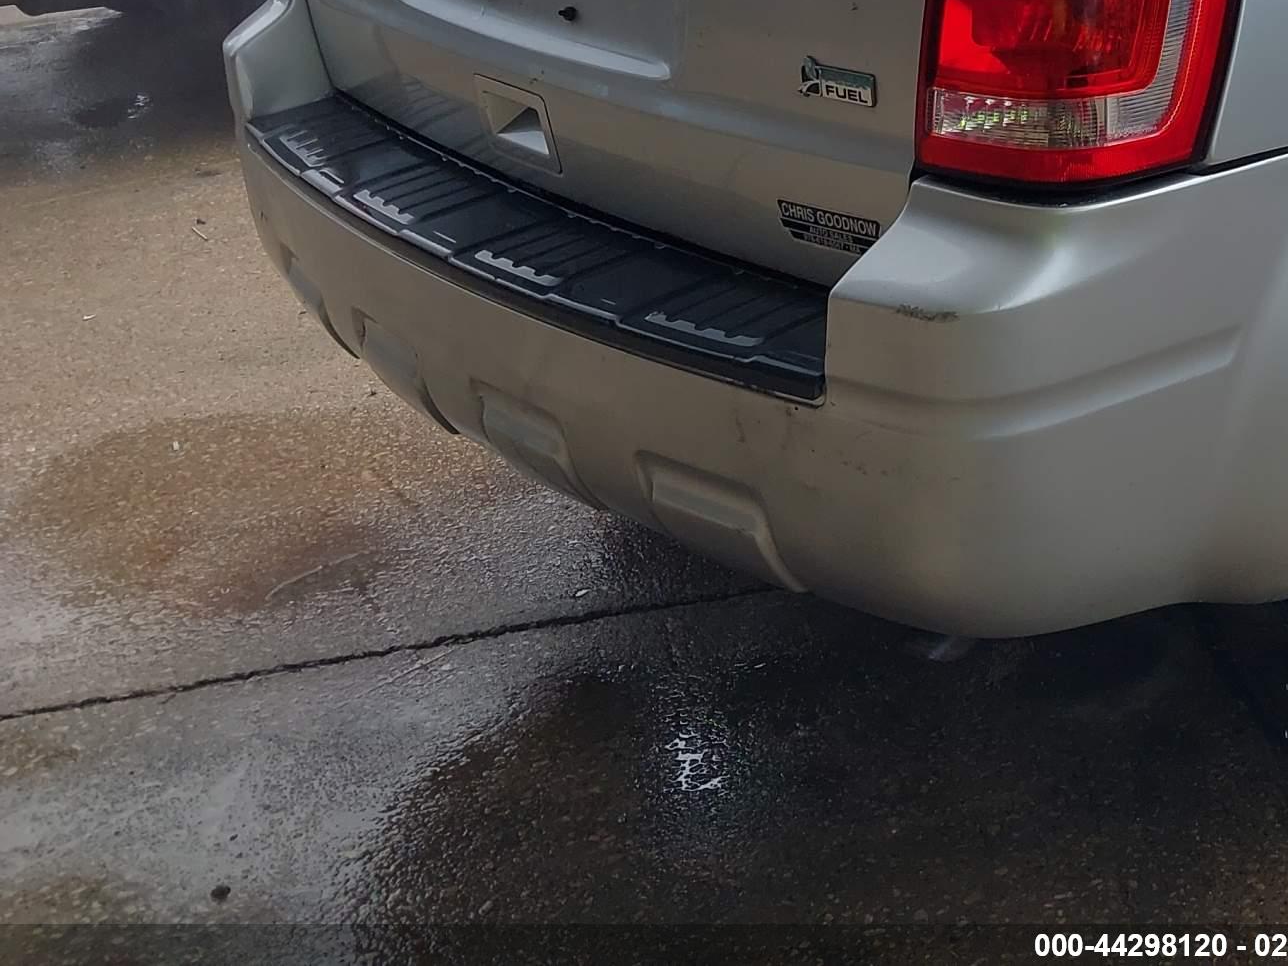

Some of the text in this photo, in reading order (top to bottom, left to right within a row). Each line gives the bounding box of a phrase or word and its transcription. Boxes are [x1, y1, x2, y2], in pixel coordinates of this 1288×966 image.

[825, 83, 869, 104] FUEL
[780, 202, 877, 237] CHRIS GOODNOW
